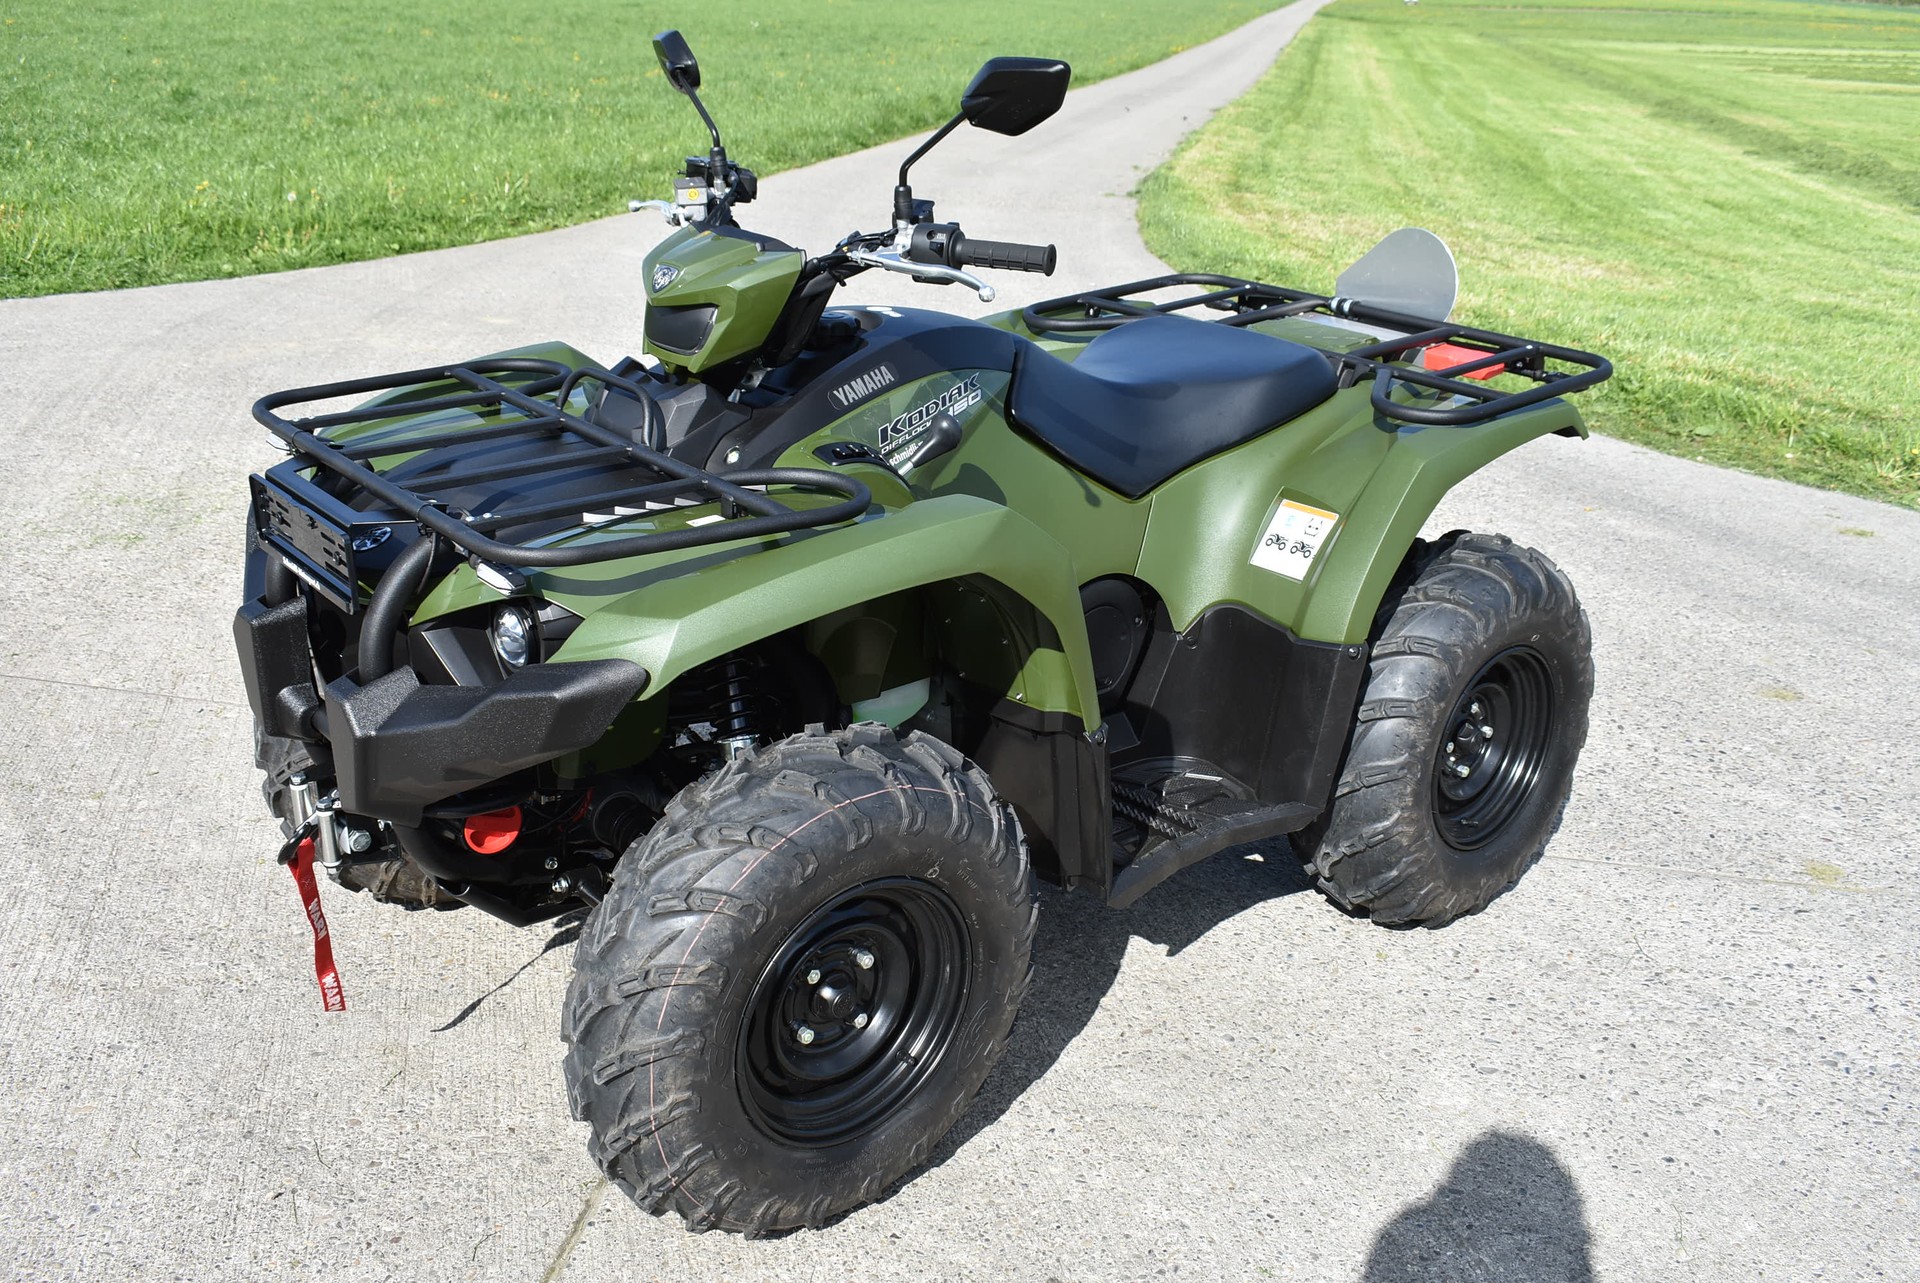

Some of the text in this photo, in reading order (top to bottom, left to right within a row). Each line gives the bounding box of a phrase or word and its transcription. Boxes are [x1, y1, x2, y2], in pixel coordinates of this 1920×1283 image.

[833, 366, 895, 406] YAMAHA
[878, 372, 981, 448] KODIAK
[309, 897, 328, 941] WARN
[322, 972, 343, 1012] WARN
